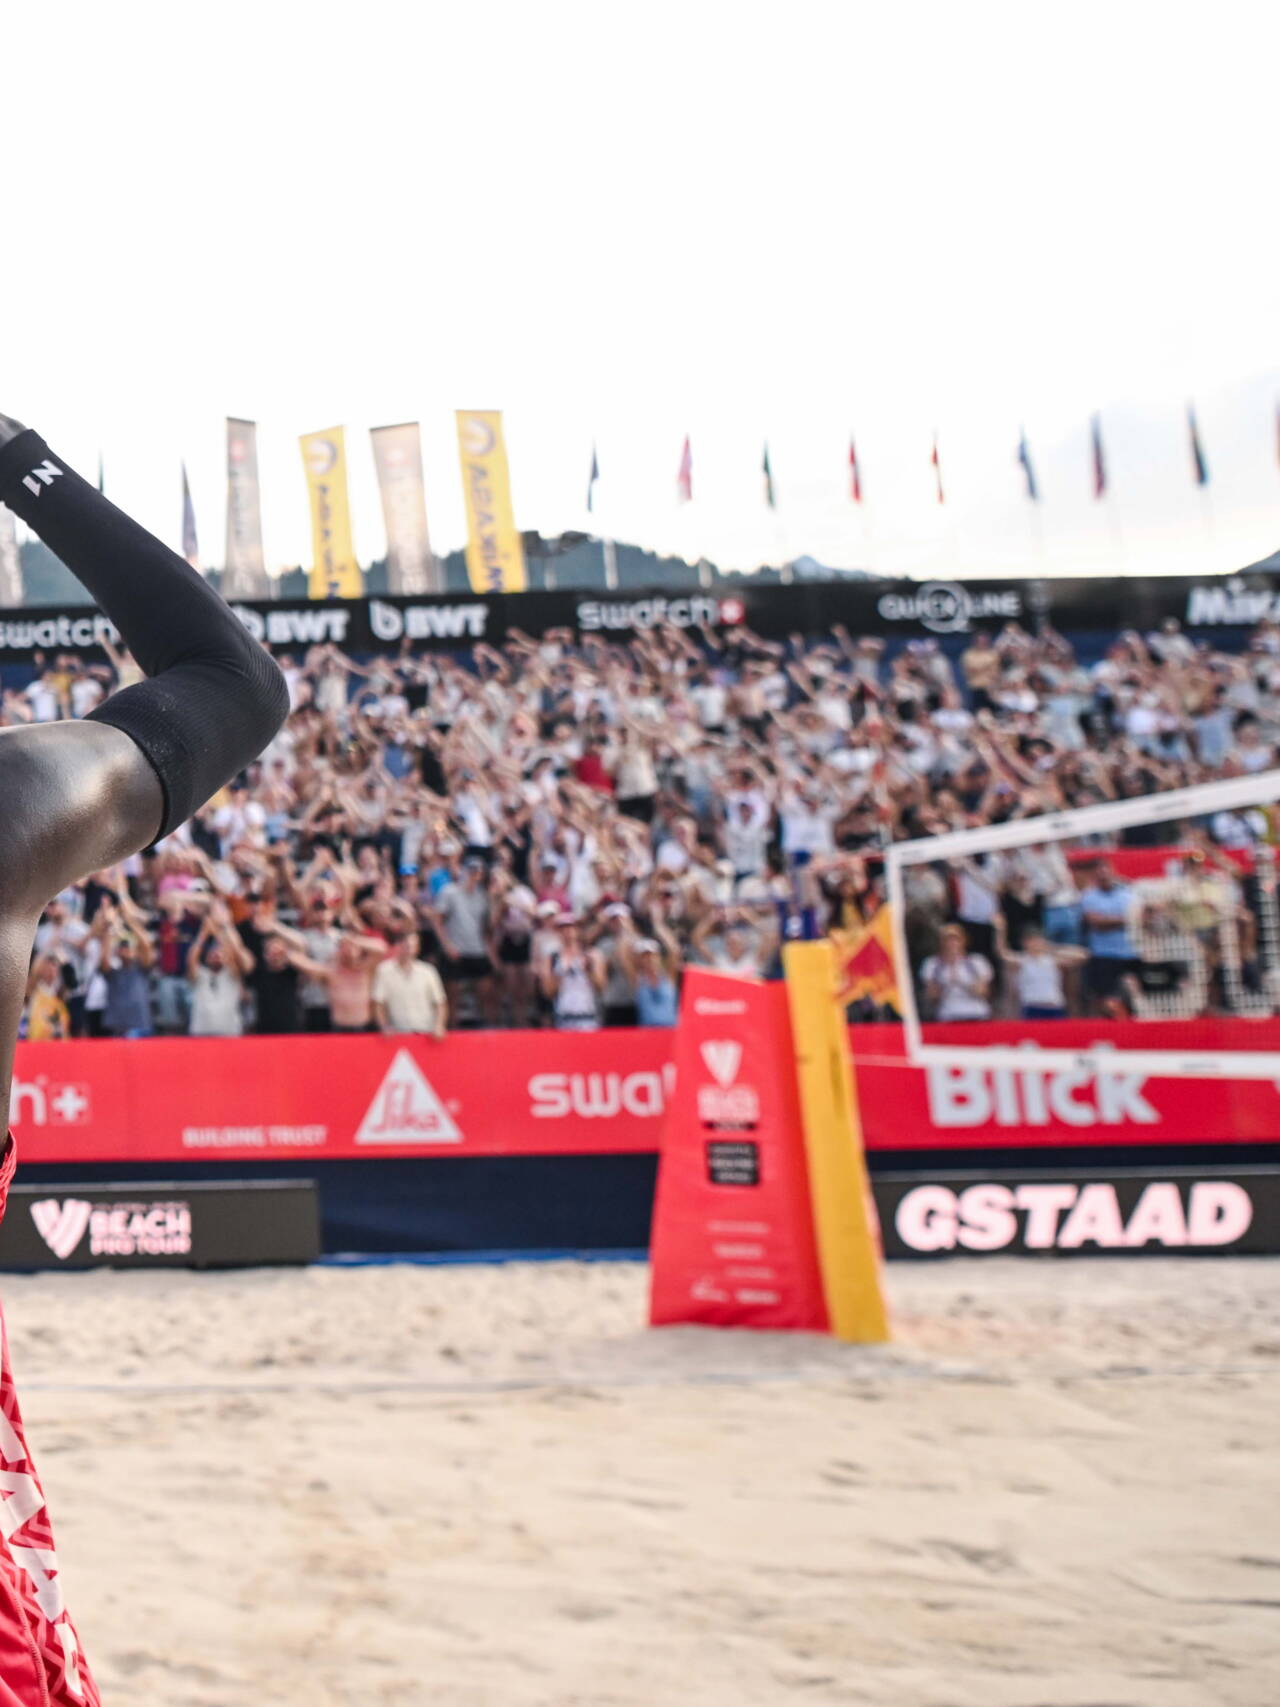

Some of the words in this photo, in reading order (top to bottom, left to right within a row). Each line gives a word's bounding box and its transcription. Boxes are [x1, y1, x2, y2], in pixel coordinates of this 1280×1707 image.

[266, 607, 349, 644] BWT
[404, 603, 488, 639] BWT
[925, 1039, 1162, 1128] Blick
[90, 1209, 192, 1237] BEACH
[895, 1180, 1254, 1252] GSTAAD
